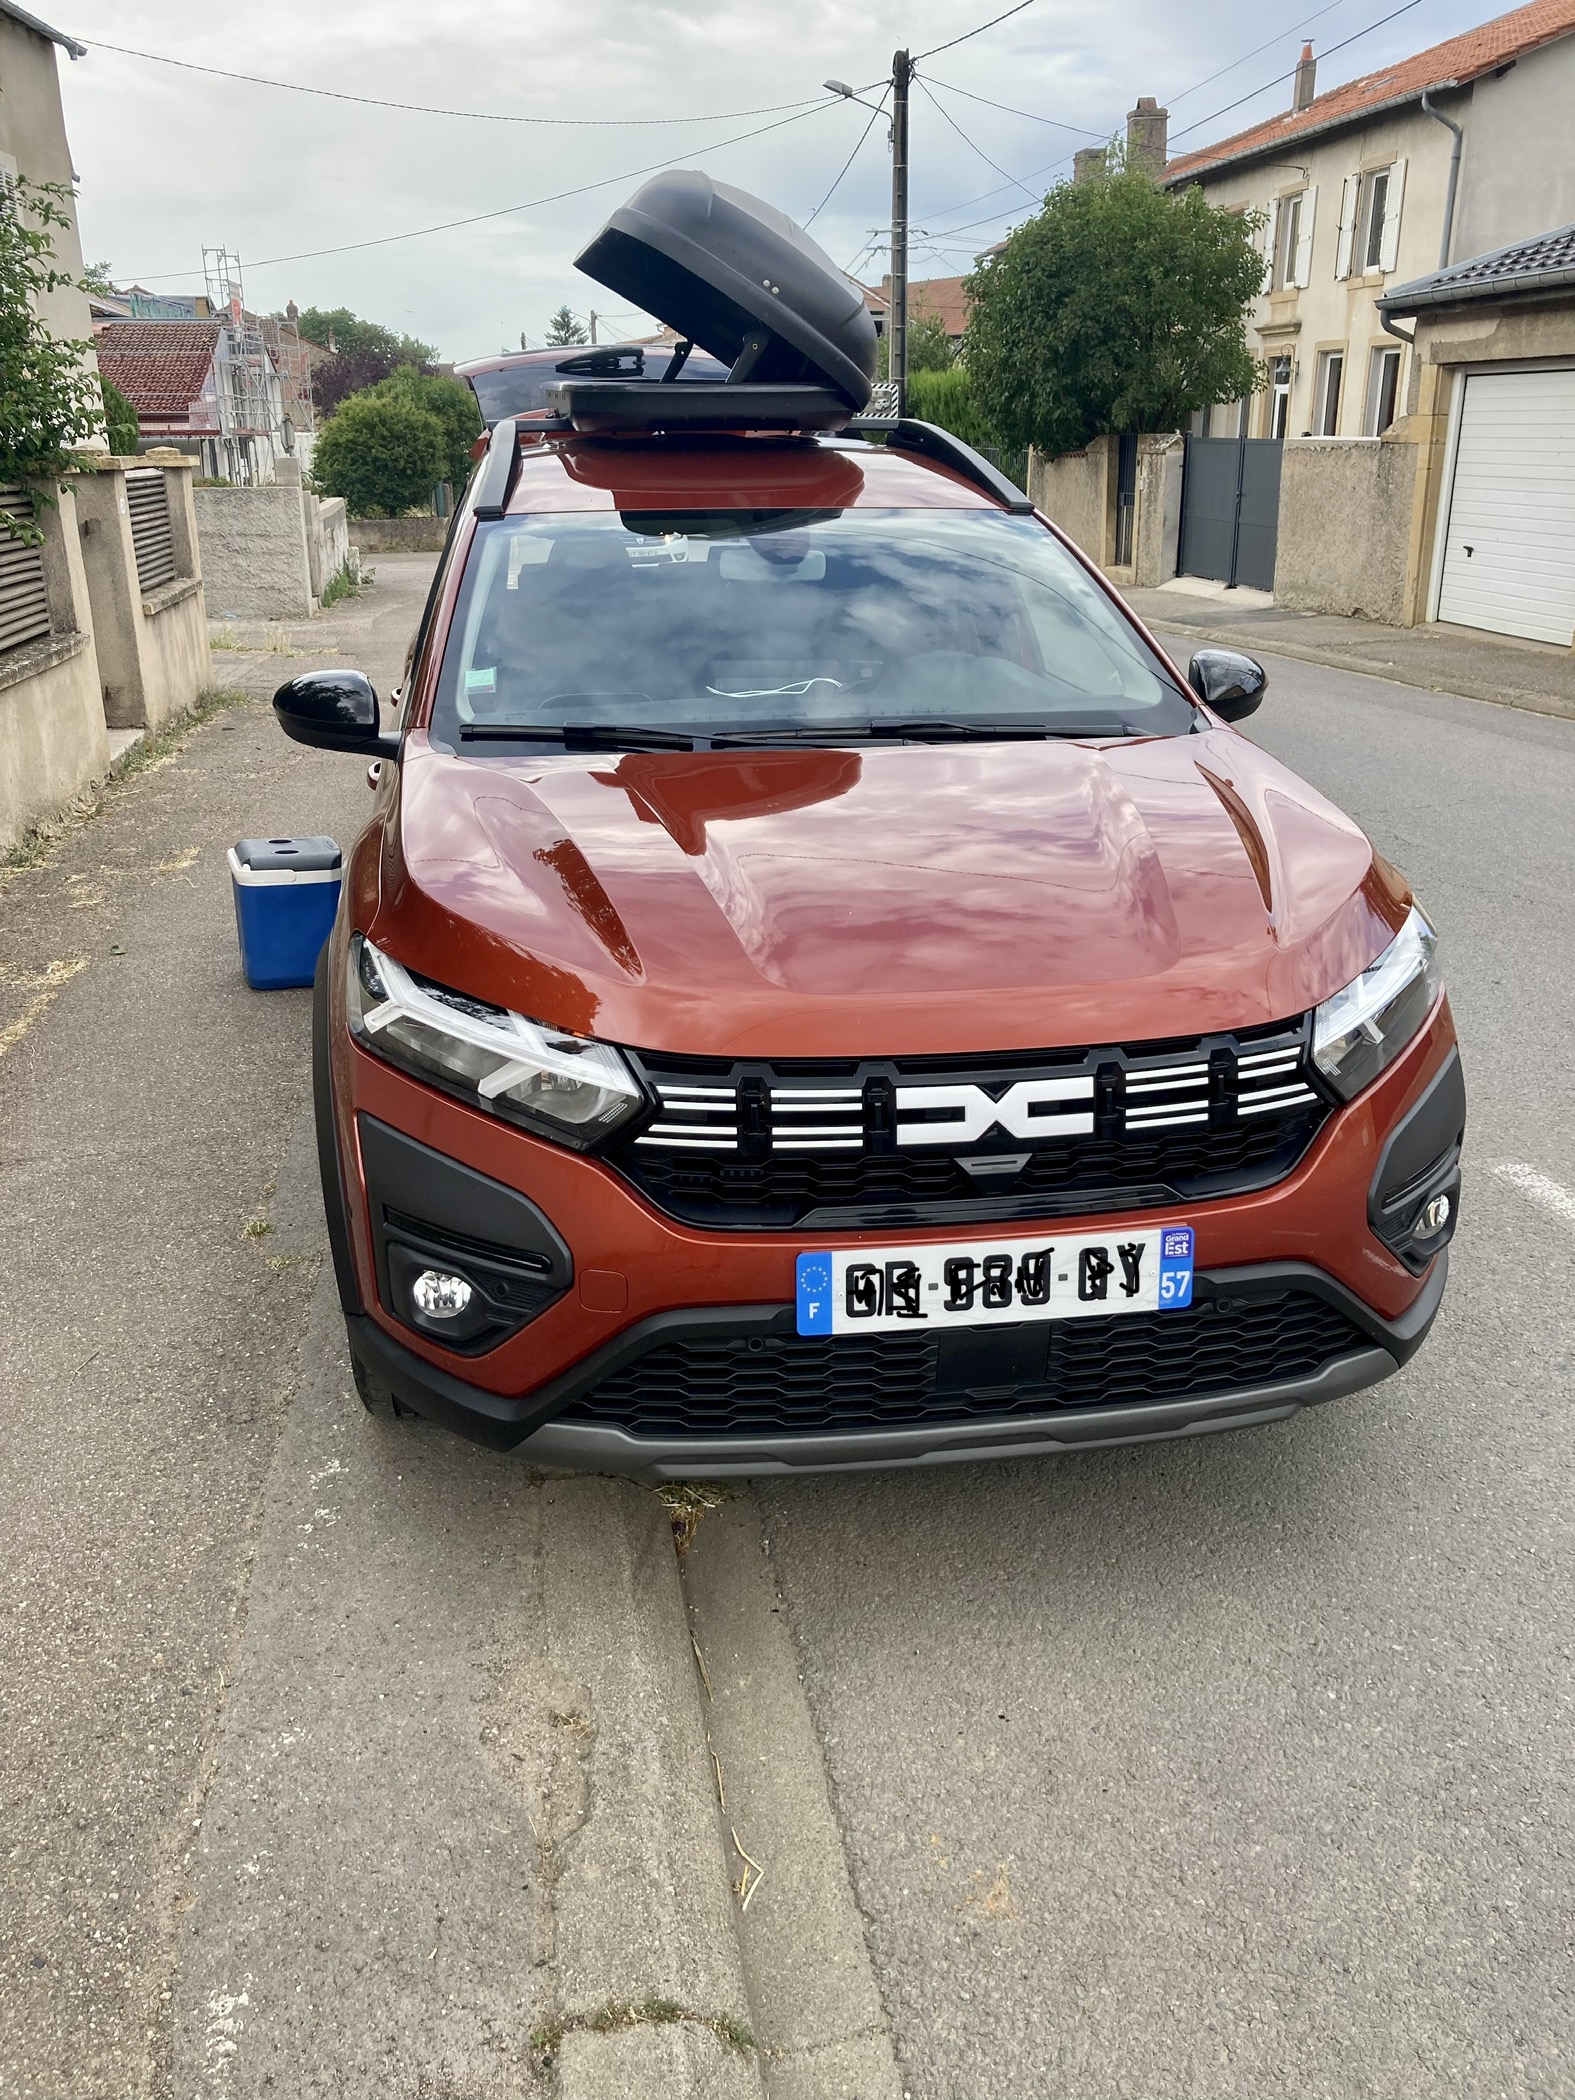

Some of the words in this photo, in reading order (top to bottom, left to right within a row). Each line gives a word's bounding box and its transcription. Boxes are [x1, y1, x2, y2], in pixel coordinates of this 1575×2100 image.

[1165, 1233, 1189, 1242] Grand
[1164, 1241, 1189, 1255] Est
[1161, 1270, 1191, 1299] 57
[809, 1302, 820, 1319] F
